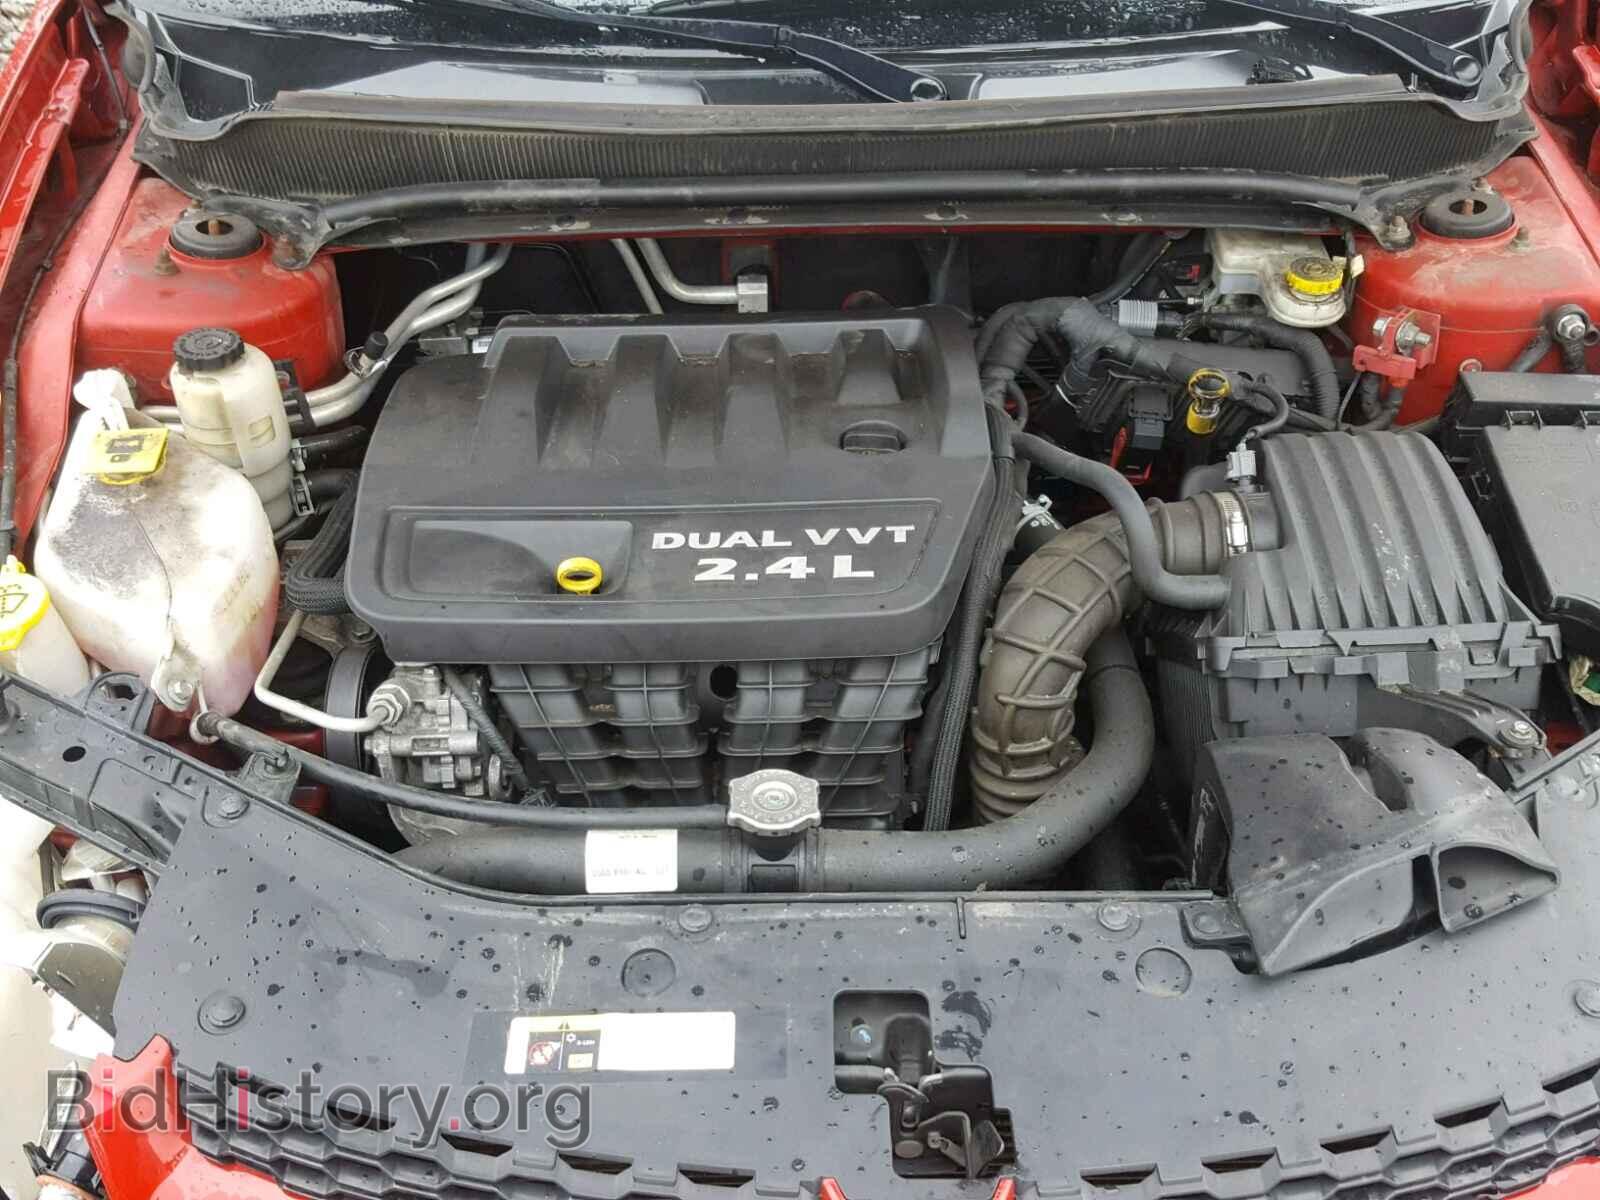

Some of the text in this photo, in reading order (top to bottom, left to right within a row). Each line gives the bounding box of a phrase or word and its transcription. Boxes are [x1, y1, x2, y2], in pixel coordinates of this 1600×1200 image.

[651, 525, 916, 549] DUAL VVT
[694, 554, 875, 581] 2.4 L
